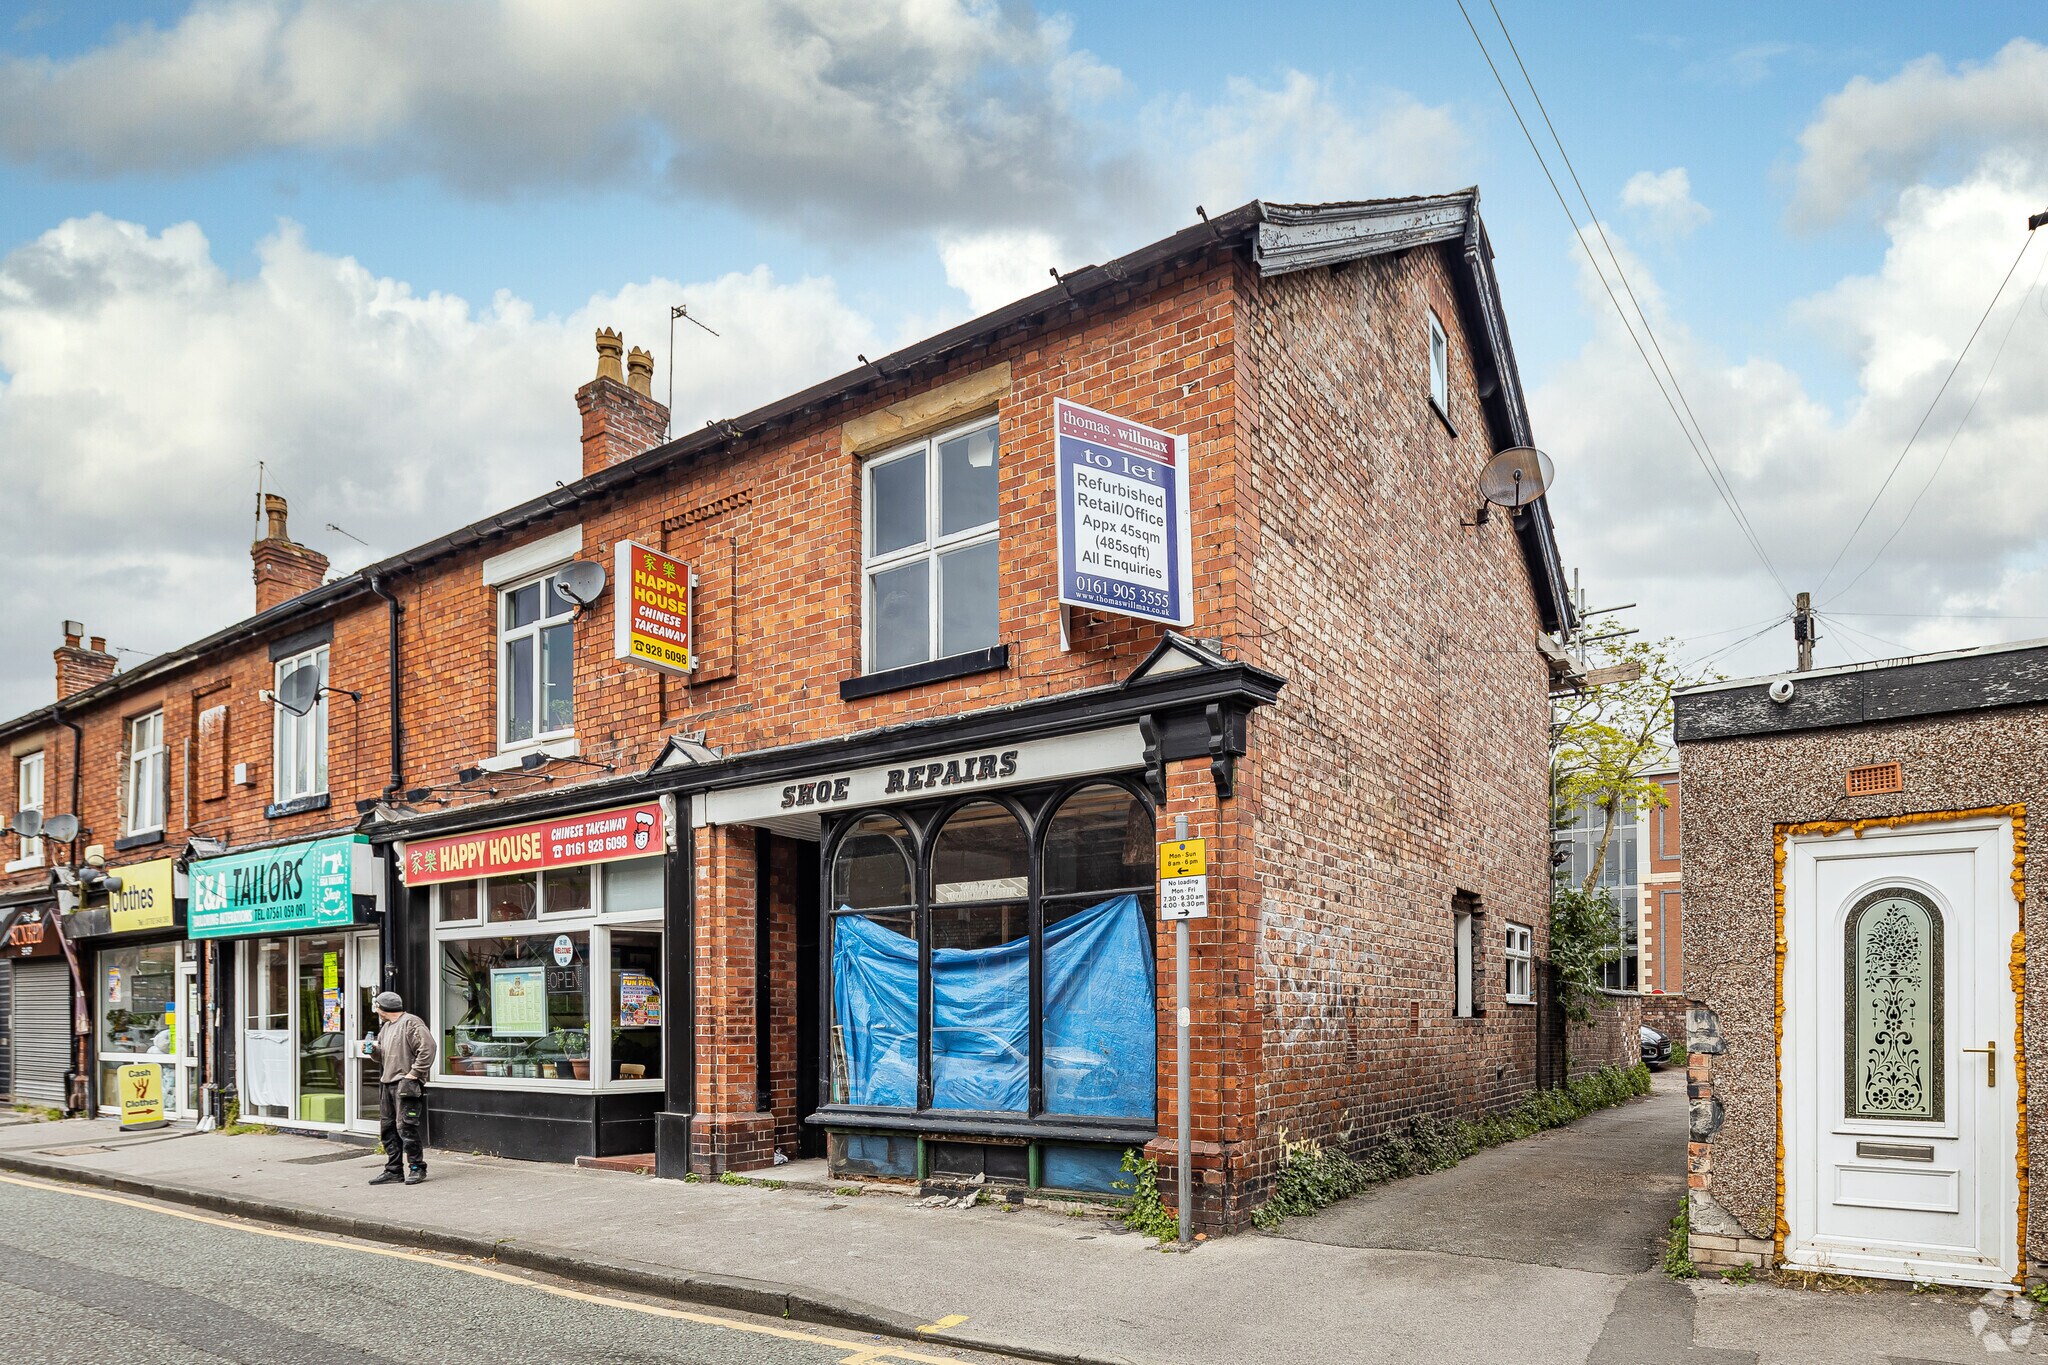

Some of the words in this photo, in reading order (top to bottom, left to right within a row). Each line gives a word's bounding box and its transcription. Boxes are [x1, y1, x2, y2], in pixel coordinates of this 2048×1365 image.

[1063, 410, 1110, 435] thomas
[1118, 428, 1168, 453] willmax
[1084, 449, 1112, 468] to
[1122, 456, 1156, 482] let
[1077, 472, 1163, 508] Refurbished
[1077, 492, 1164, 527] Retail/Office
[1082, 514, 1116, 534] Appx
[1120, 523, 1160, 546] 45sqm
[1095, 535, 1150, 561] (485sqft)
[1082, 550, 1100, 566] All
[1104, 554, 1162, 579] Enquiries
[635, 569, 686, 599] HAPPY
[1076, 576, 1108, 596] 0161
[1113, 583, 1136, 601] 905
[1140, 589, 1169, 608] 3555
[634, 585, 687, 616] HOUSE
[1076, 592, 1170, 616] www.thomaswillmax.co.uk
[634, 618, 686, 643] TAKEAWAY
[639, 606, 681, 628] CHINESE
[645, 643, 662, 657] 928
[665, 649, 687, 664] 6098
[781, 777, 850, 809] SHOE
[884, 750, 1019, 794] REPAIRS
[551, 823, 584, 841] CHINESE
[585, 817, 628, 836] TAKEAWAY
[440, 840, 486, 872] HAPPY
[489, 832, 542, 866] HOUSE
[565, 841, 585, 856] 0161
[588, 838, 604, 853] 928
[605, 835, 628, 851] 6098
[112, 884, 154, 913] Clothes
[194, 871, 228, 912] E&A
[233, 858, 303, 907] TAILORS
[323, 887, 341, 903] Shop
[266, 905, 283, 920] 07561
[284, 904, 295, 918] 059
[295, 903, 306, 917] 091
[550, 971, 580, 988] OPEN
[638, 979, 655, 987] PARK
[128, 1069, 151, 1078] Cash
[125, 1098, 159, 1108] Clothes
